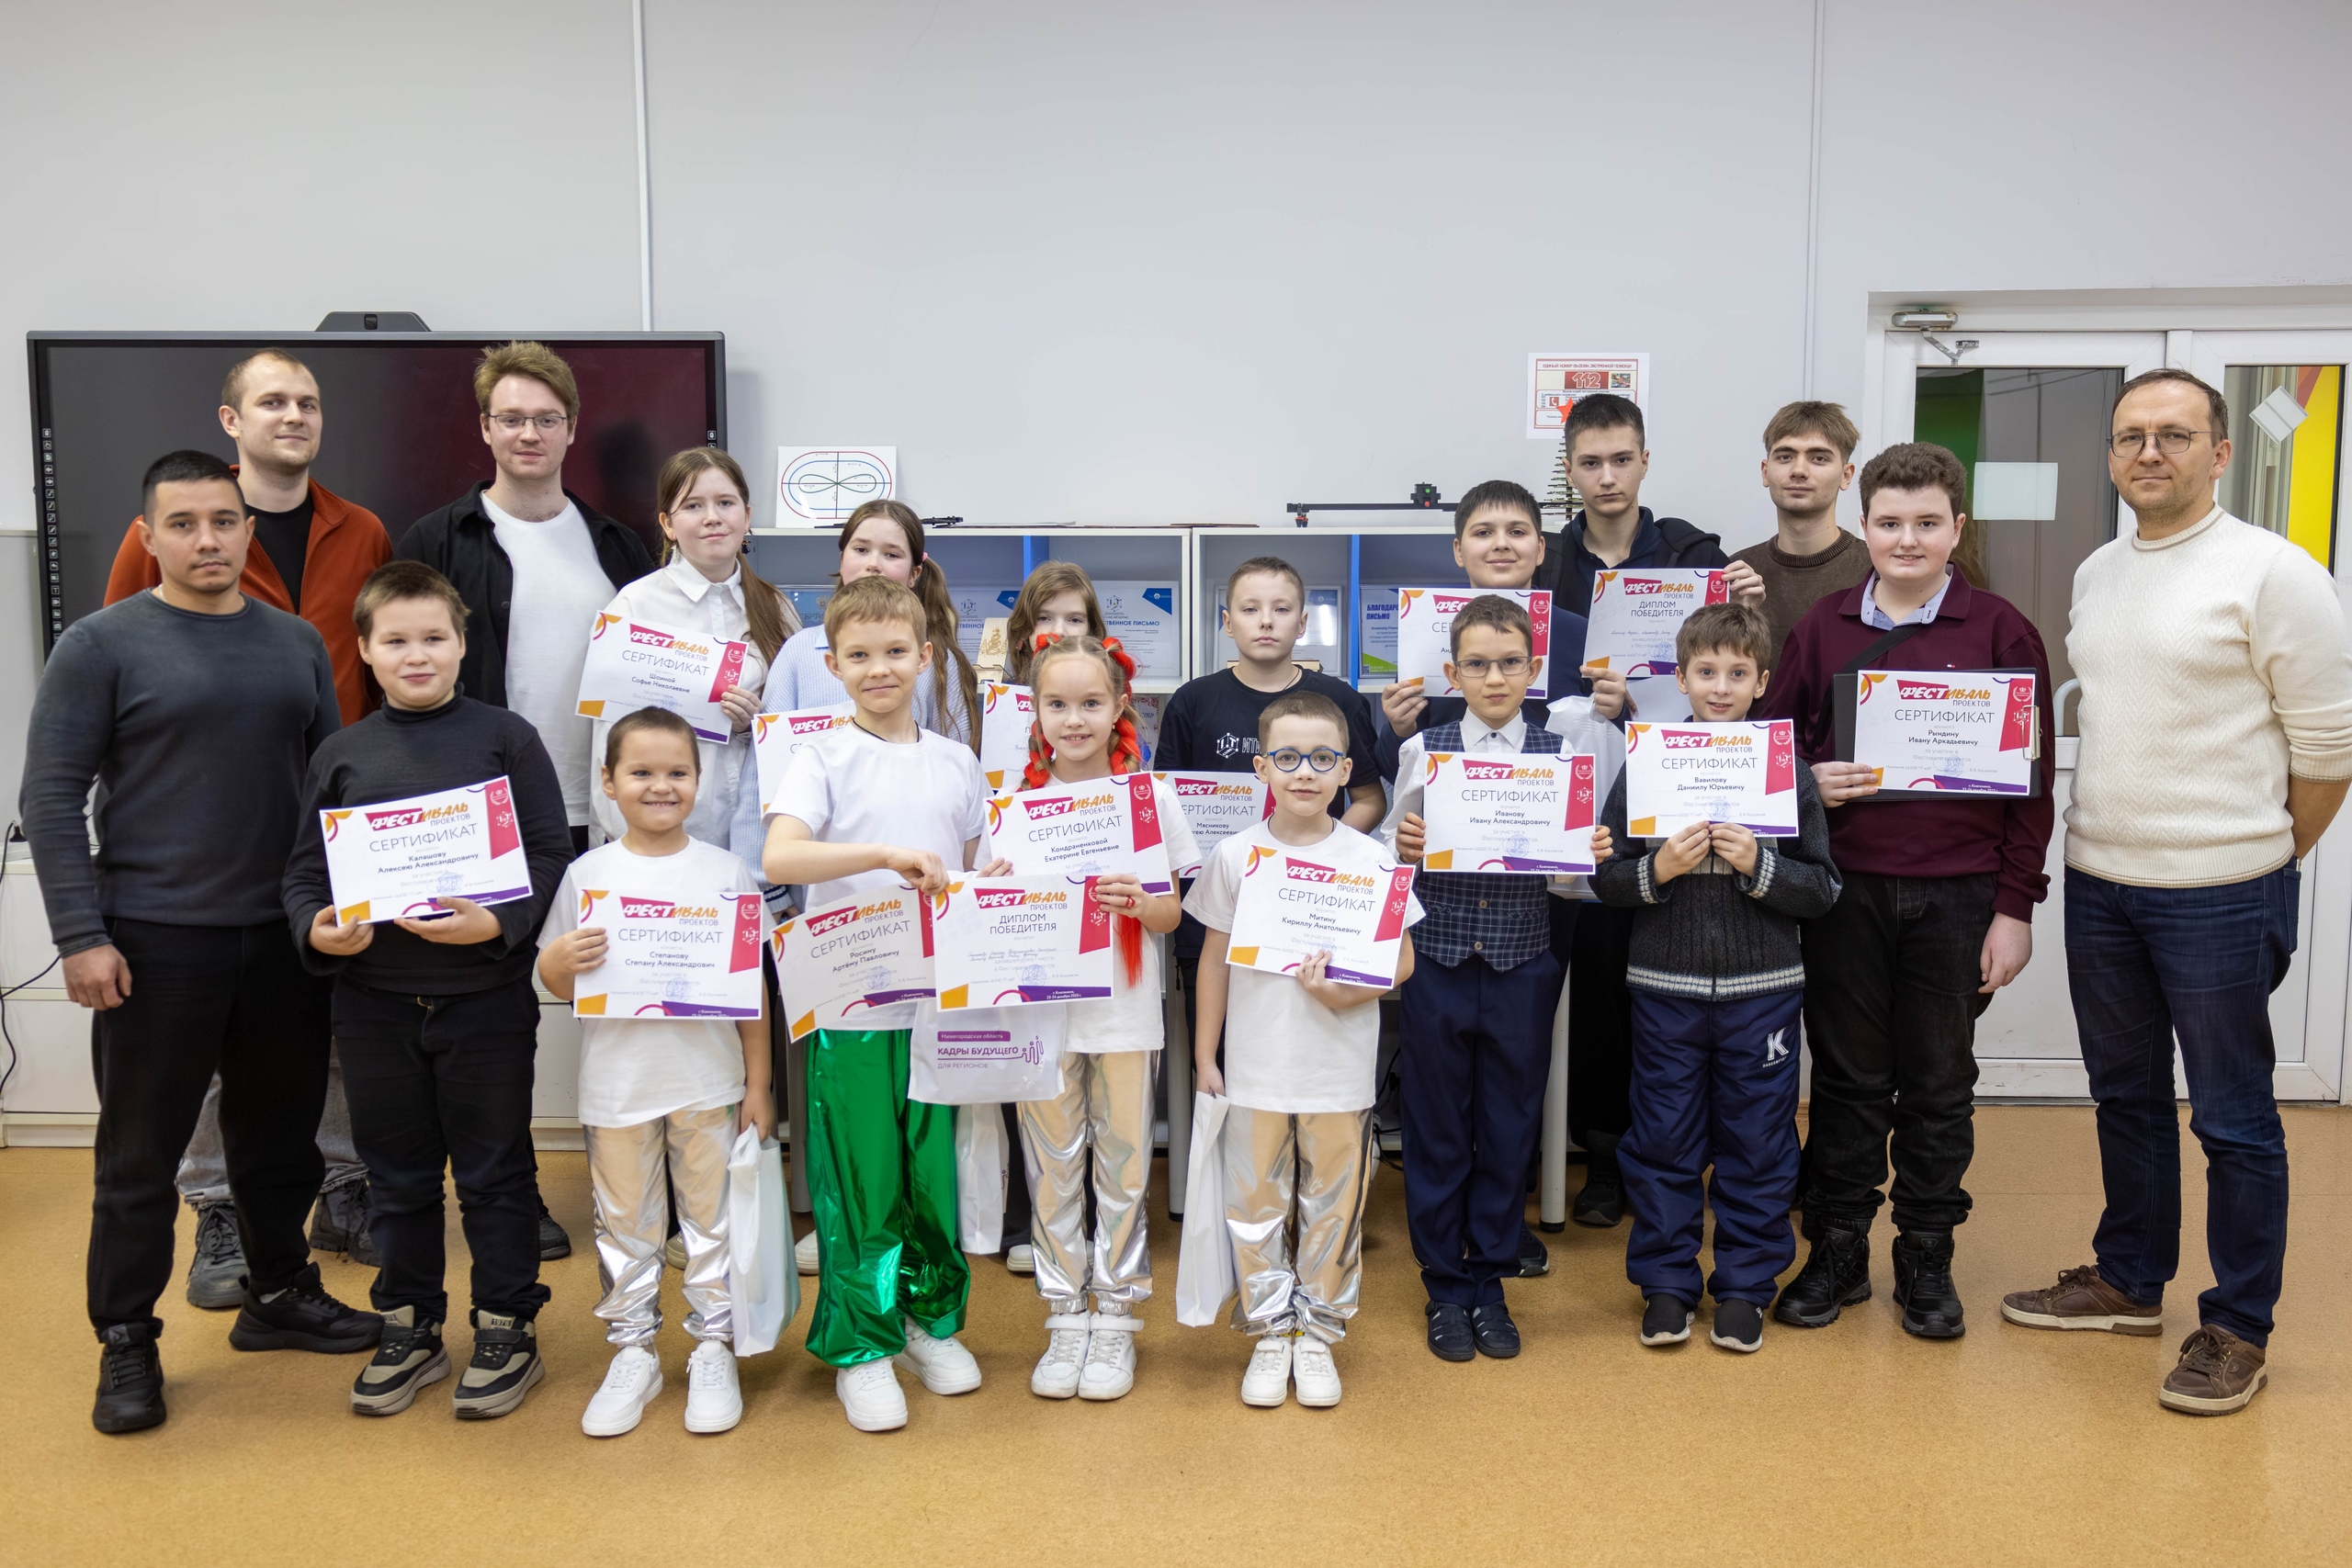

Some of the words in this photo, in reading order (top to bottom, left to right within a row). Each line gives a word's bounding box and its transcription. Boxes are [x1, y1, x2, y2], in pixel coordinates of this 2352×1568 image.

[1572, 372, 1601, 388] 112
[1625, 582, 1694, 593] ФЕСТИВАЛЬ
[1631, 610, 1683, 618] ПОБЕДИТЕЛЯ
[630, 631, 710, 655] ФЕСТИВАЛЬ
[622, 650, 710, 676] СЕРТИФИКАТ
[675, 650, 708, 662] ПРОЕКТОВ
[632, 676, 651, 686] Софье
[653, 680, 690, 693] Николаевне
[649, 673, 675, 683] Шоиной
[1900, 687, 1991, 700] ФЕСТИВАЛЬ
[1894, 709, 1995, 724] СЕРТИФИКАТ
[793, 715, 853, 733] ФЕСТИВА
[1664, 735, 1752, 747] ФЕСТИВАЛЬ
[1932, 738, 1978, 746] Аркадьевичу
[1661, 757, 1758, 770] СЕРТИФИКАТ
[1466, 766, 1554, 779] ФЕСТИВАЛЬ
[1177, 783, 1253, 795] ФЕСТИВАЛЬ
[1462, 789, 1559, 802] СЕРТИФИКАТ
[1029, 793, 1114, 818] ФЕСТИВАЛЬ
[1080, 804, 1116, 817] ПРОЕКТОВ
[1181, 805, 1256, 816] ЕРТИФИКАТ
[371, 802, 468, 829] ФЕСТИВАЛЬ
[430, 813, 471, 827] ПРОЕКТОВ
[1028, 815, 1123, 842] СЕРТИФИКАТ
[370, 823, 478, 852] СЕРТИФИКАТ
[1051, 838, 1108, 853] Кондраненковой
[409, 851, 447, 862] Калашову
[1045, 852, 1080, 863] Екатерине
[1081, 844, 1120, 856] Евгеньевне
[378, 863, 413, 874] Алексею
[415, 853, 479, 869] Александровичу
[1286, 865, 1375, 888] ФЕСТИВАЛЬ
[1337, 884, 1373, 895] ПРОЕКТОВ
[978, 892, 1067, 907] ФЕСТИВАЛЬ
[1278, 888, 1376, 912] СЕРТИФИКАТ
[623, 904, 718, 918] ФЕСТИВАЛЬ
[810, 898, 902, 934] ФЕСТИВАЛЬ
[864, 910, 904, 924] ПРОЕКТОВ
[1000, 914, 1046, 925] ДИПЛОМ
[1282, 916, 1312, 929] Кириллу
[1313, 922, 1361, 935] Анатольевичу
[1309, 913, 1337, 924] Митину
[618, 929, 723, 943] СЕРТИФИКАТ
[990, 923, 1057, 935] ПОБЕДИТЕЛЯ
[811, 920, 911, 959] СЕРТИФИКАТ
[650, 952, 688, 960] Степанову
[850, 948, 876, 959] Росину
[625, 959, 655, 967] Степану
[832, 960, 858, 973] Артёму
[860, 950, 900, 964] Павловичу
[938, 1048, 969, 1056] КАДРЫ
[971, 1047, 1018, 1056] БУДУЩЕГО
